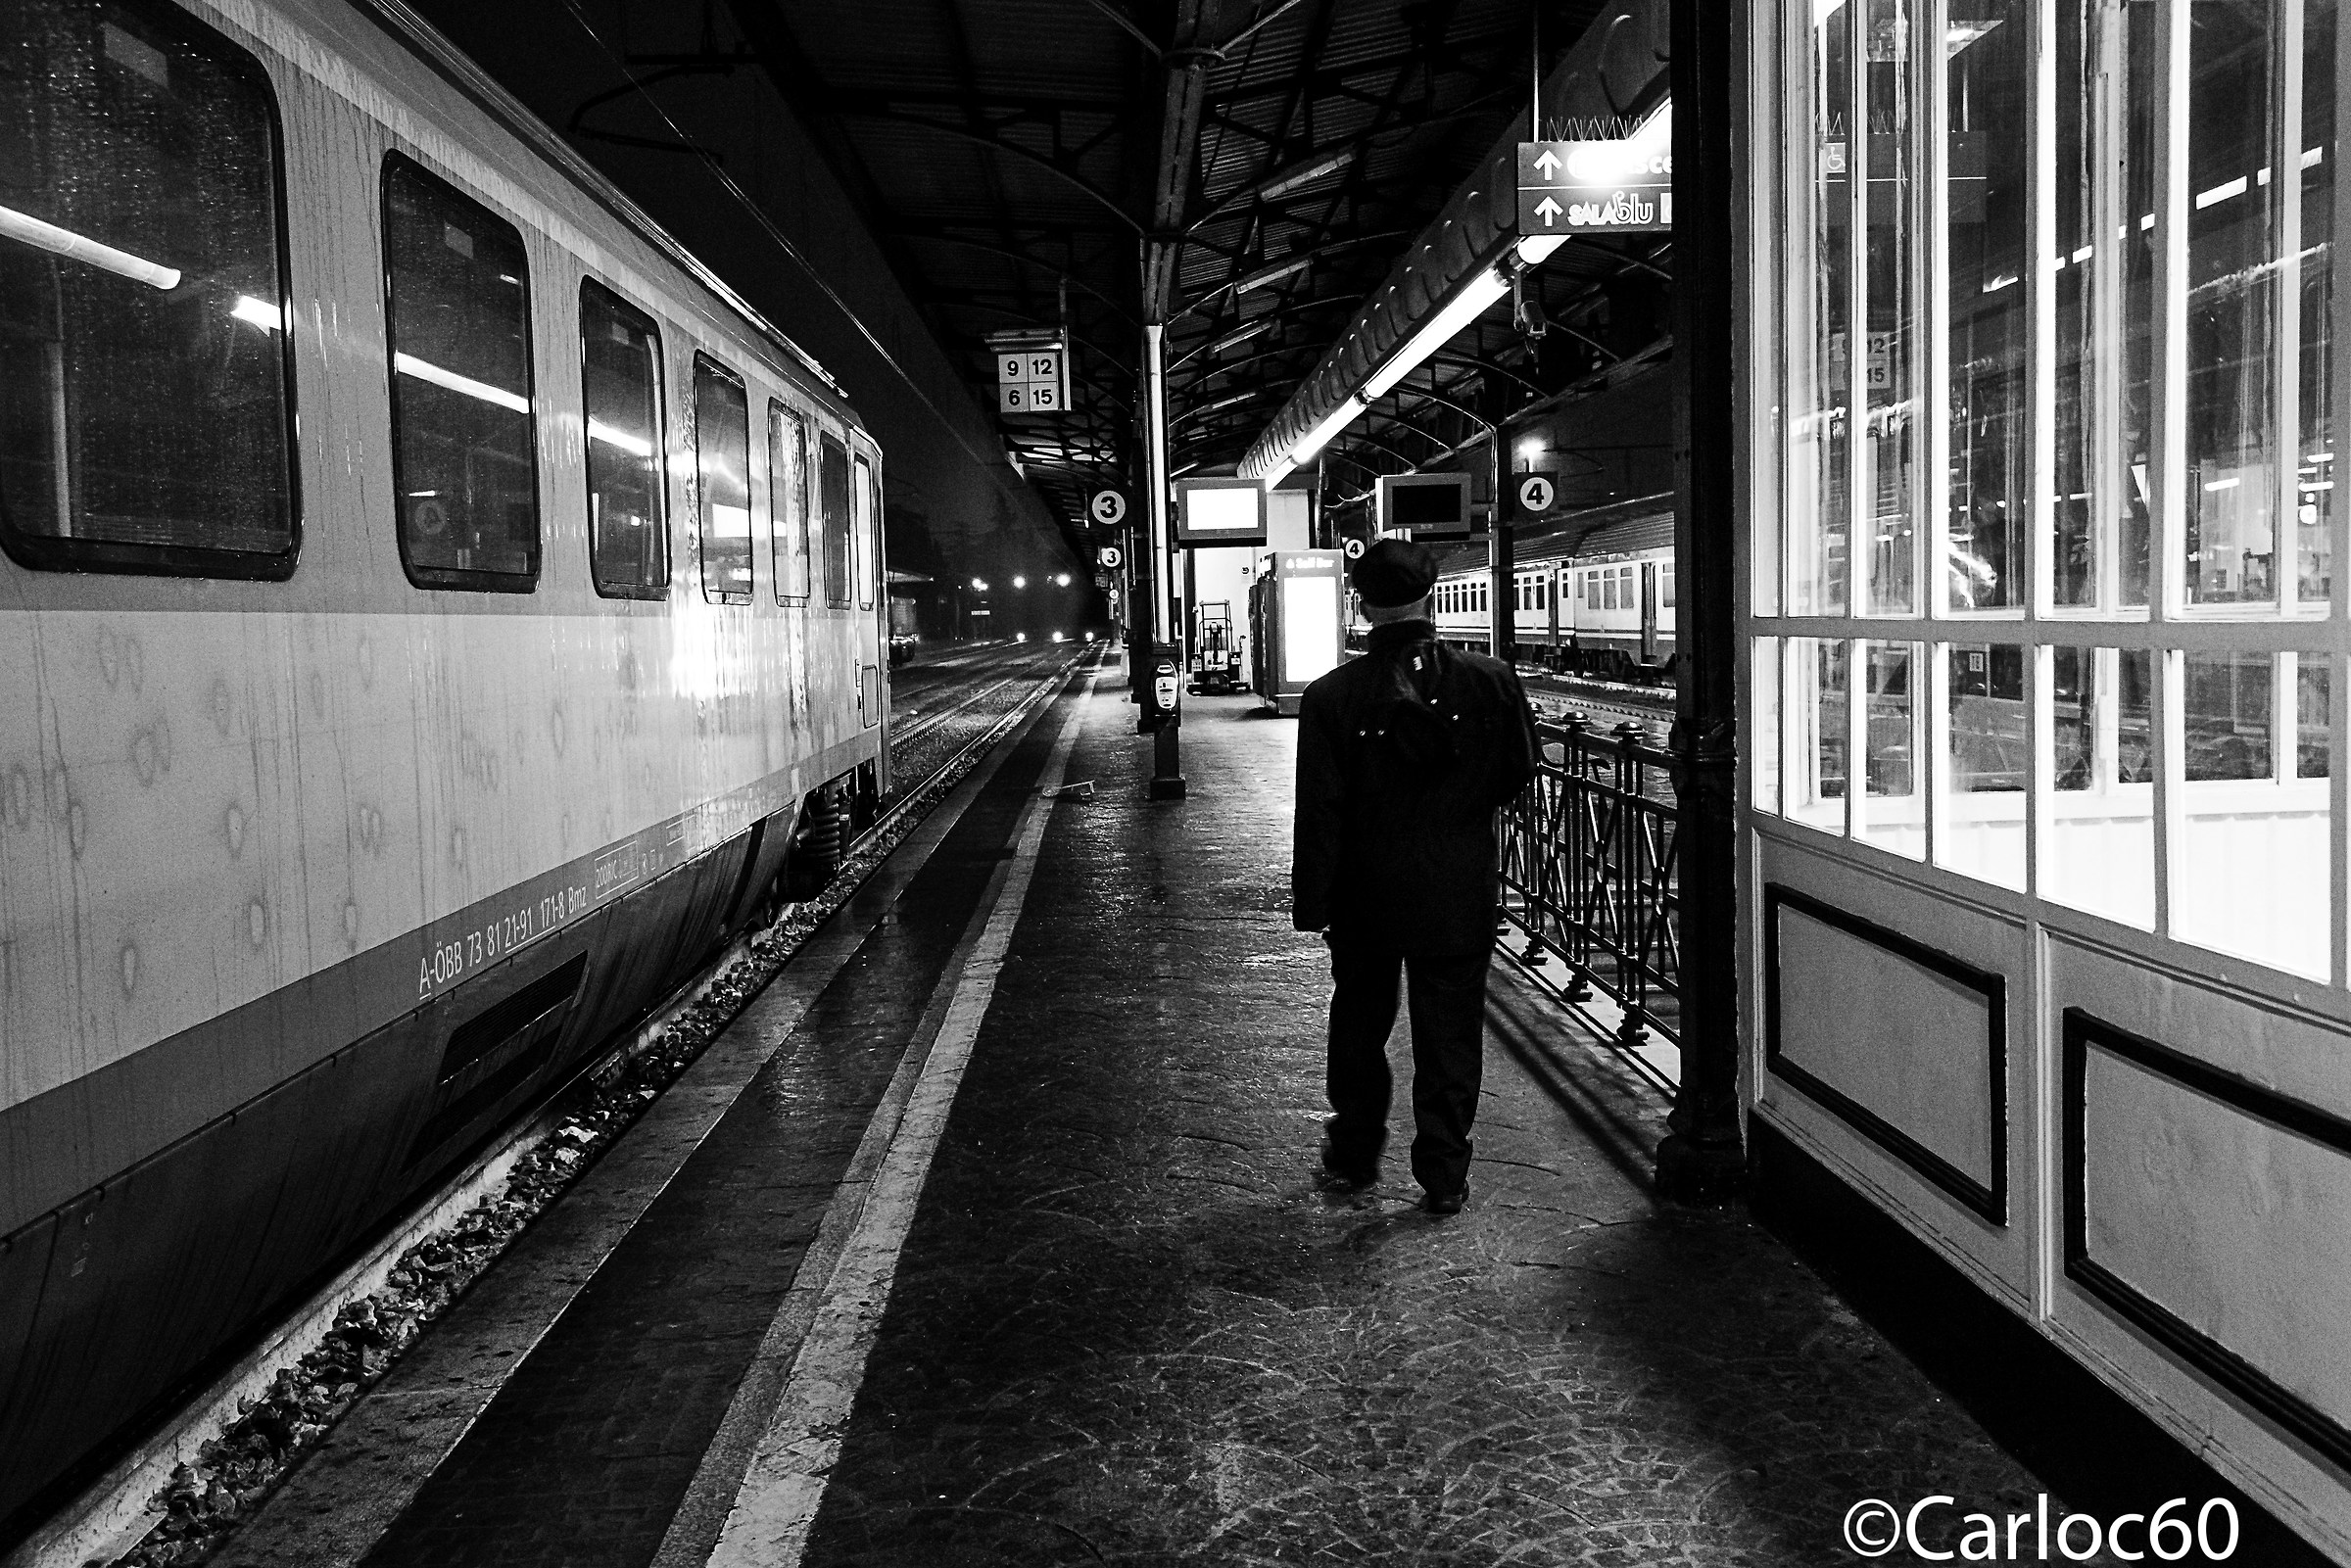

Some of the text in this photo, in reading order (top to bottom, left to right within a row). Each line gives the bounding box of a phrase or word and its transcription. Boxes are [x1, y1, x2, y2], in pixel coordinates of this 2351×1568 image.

[1007, 358, 1053, 376] 9 12
[1009, 389, 1053, 406] 6 15
[1526, 483, 1545, 505] 4
[1100, 496, 1118, 519] 3
[1107, 550, 1117, 564] 3
[1349, 543, 1360, 555] 4
[467, 933, 483, 968] 73
[487, 925, 502, 957] 81
[504, 906, 533, 948] 21-91
[540, 890, 565, 929] 171-8
[568, 885, 588, 914] Bmz
